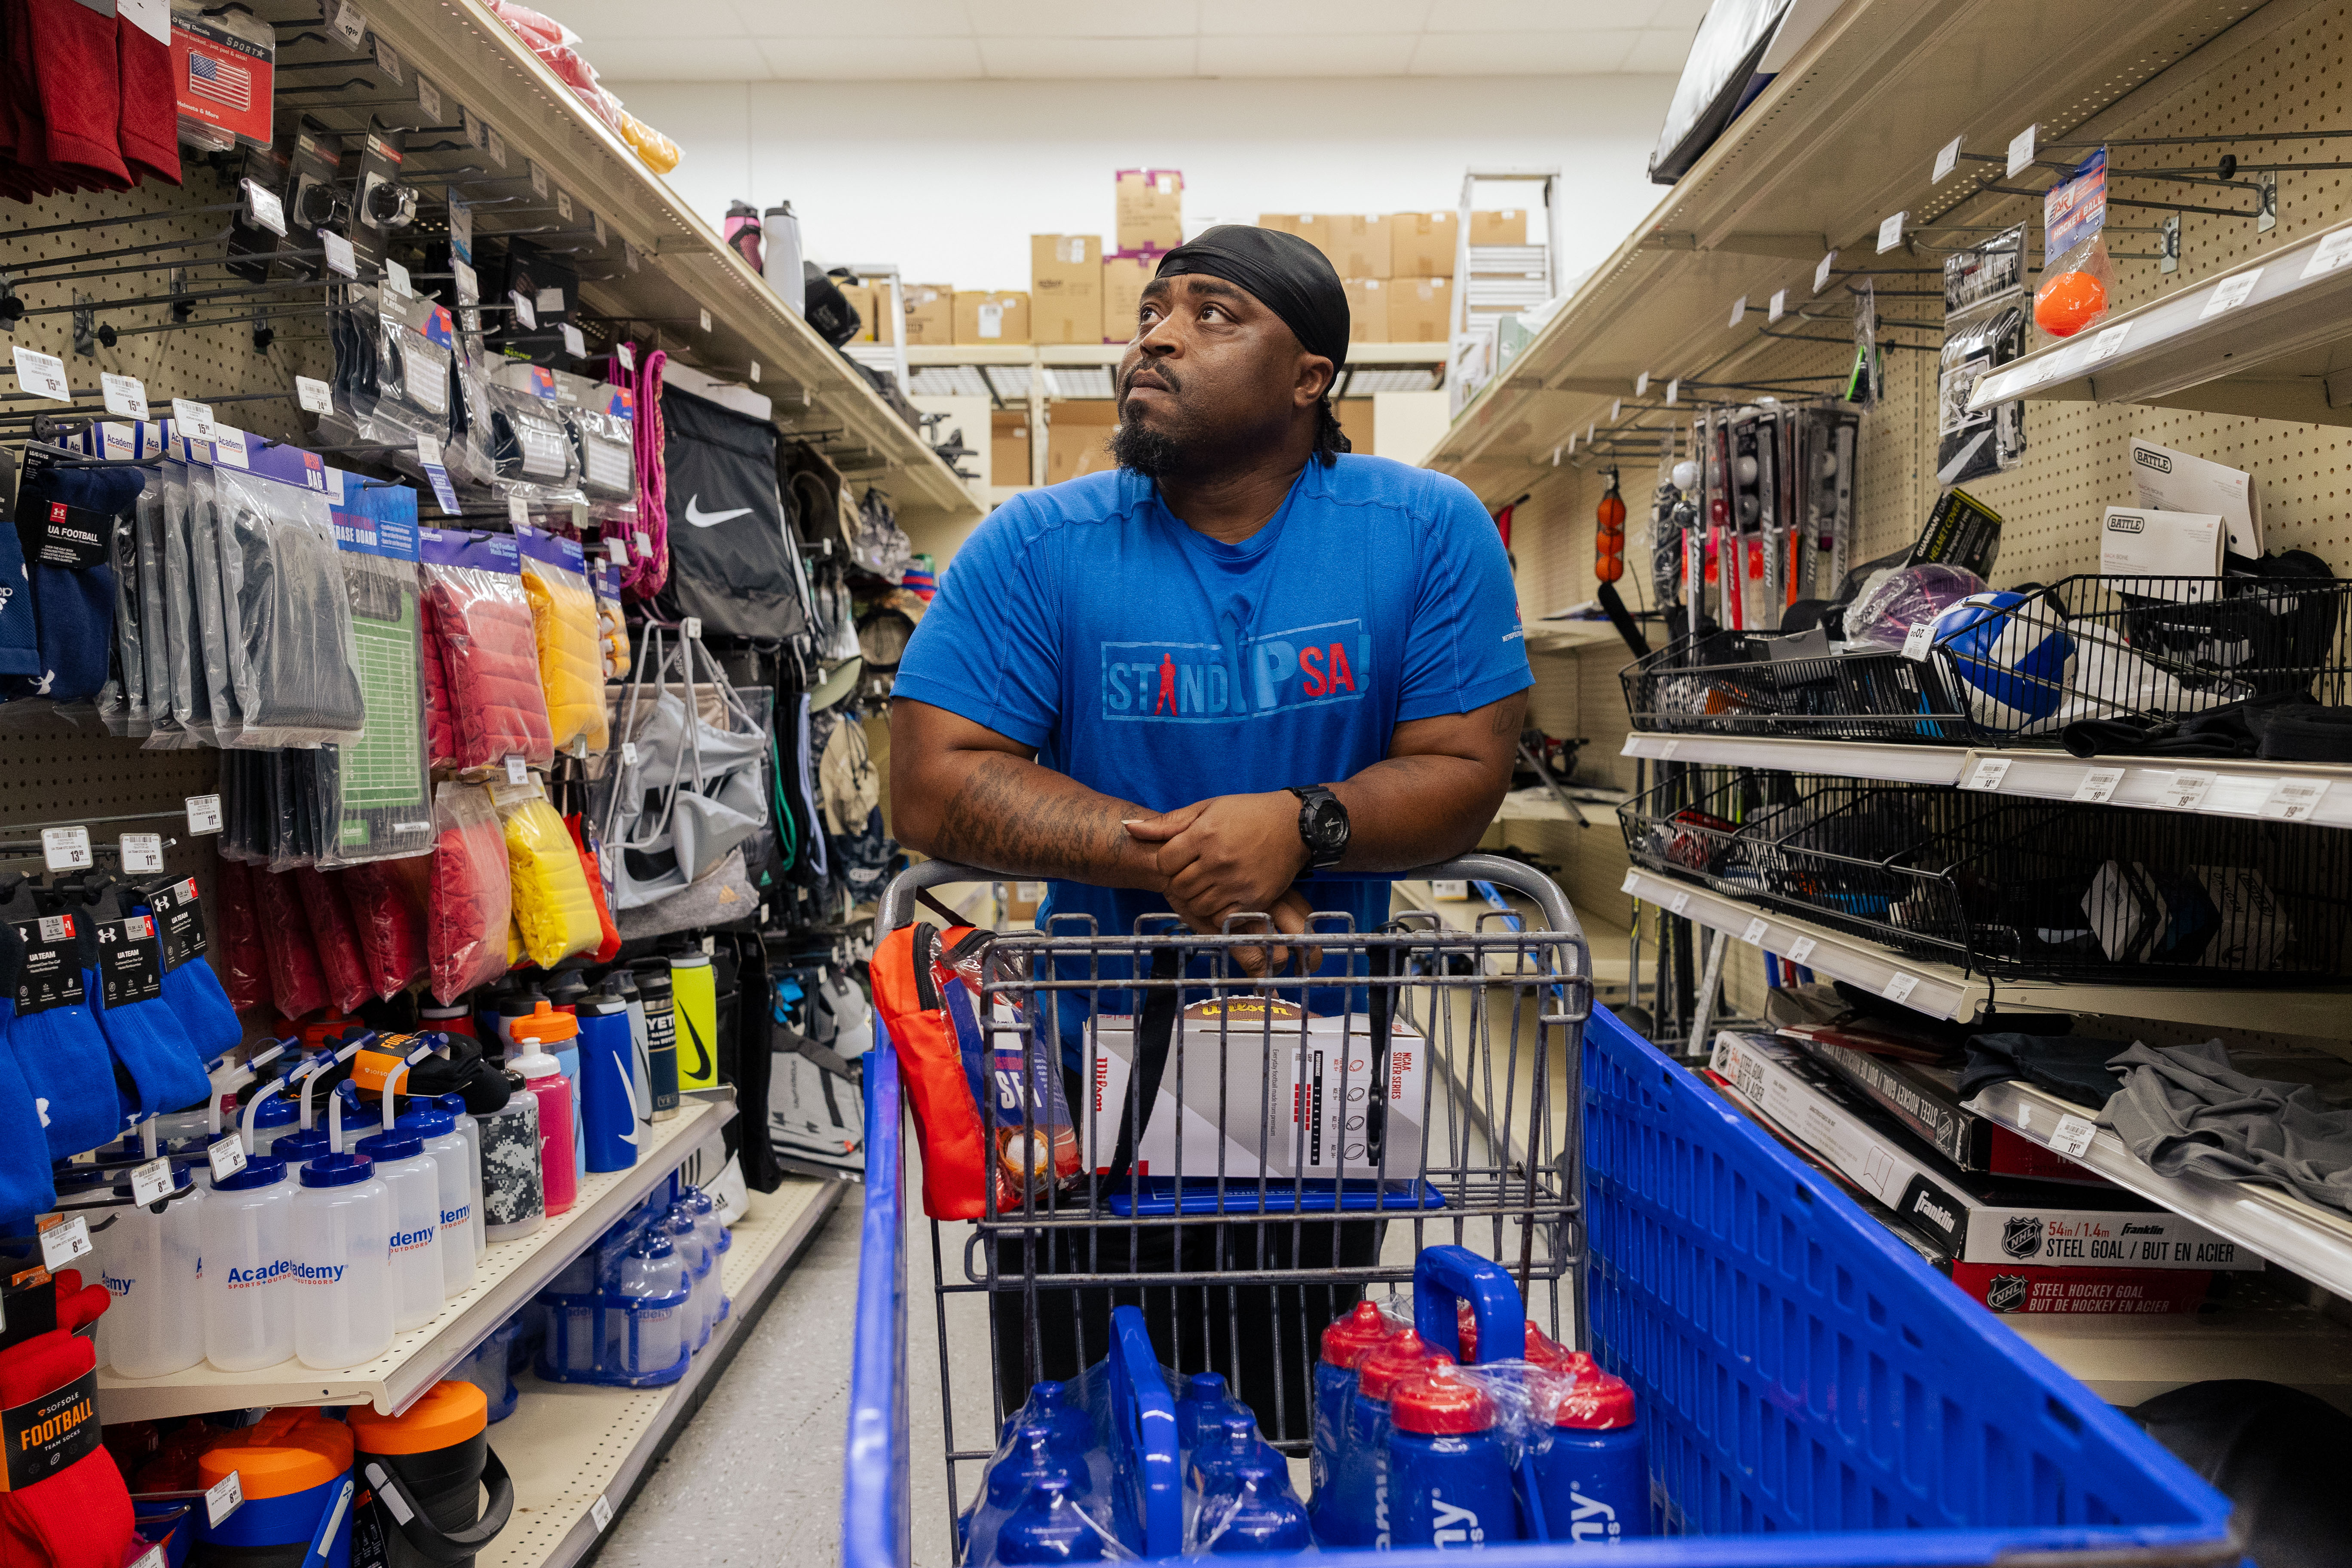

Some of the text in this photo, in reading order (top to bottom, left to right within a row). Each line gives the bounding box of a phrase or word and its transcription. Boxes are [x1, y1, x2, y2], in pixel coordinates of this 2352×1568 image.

[192, 24, 210, 36] Decals
[226, 36, 258, 55] SPORT
[177, 100, 199, 112] Helmets
[205, 110, 219, 119] More
[2054, 196, 2103, 240] HOCKEY BALL
[107, 434, 132, 449] Academ
[218, 435, 244, 453] Academy
[303, 452, 321, 471] MESH
[2137, 451, 2169, 471] BATTLE
[306, 468, 323, 490] BAG
[48, 525, 98, 542] UA FOOTBALL
[1929, 499, 1962, 560] HELMET COVER
[2110, 518, 2142, 530] BATTLE
[355, 528, 377, 546] BOARD
[1917, 515, 1940, 557] GUARDIAN
[177, 912, 188, 921] TEAM
[29, 951, 56, 962] UA TEAM
[125, 949, 139, 958] TEAM
[1403, 1052, 1412, 1071] NCAA
[1391, 1052, 1402, 1099] SILVER SERIES
[1882, 1075, 1897, 1099] GOAL
[1896, 1084, 1920, 1116] HOCKEY
[1920, 1099, 1938, 1127] STEEL
[1913, 1190, 1955, 1234] Franklin
[390, 1225, 434, 1247] demy
[2010, 1227, 2034, 1248] NHL
[2048, 1221, 2164, 1237] 54in / 1.4m Franklin
[2046, 1238, 2234, 1263] STEEL GOAL / BUT EN ACIER
[227, 1259, 291, 1283] Acade
[292, 1259, 344, 1277] ademy
[1995, 1285, 2022, 1302] NHL
[2032, 1283, 2144, 1298] STEEL HOCKEY GOAL
[2029, 1298, 2171, 1313] BUT DE HOCKEY EN ACIER
[46, 1391, 80, 1413] SOFSOLE
[21, 1397, 93, 1451] FOOTBALL
[45, 1428, 81, 1452] TEAM SOCKS
